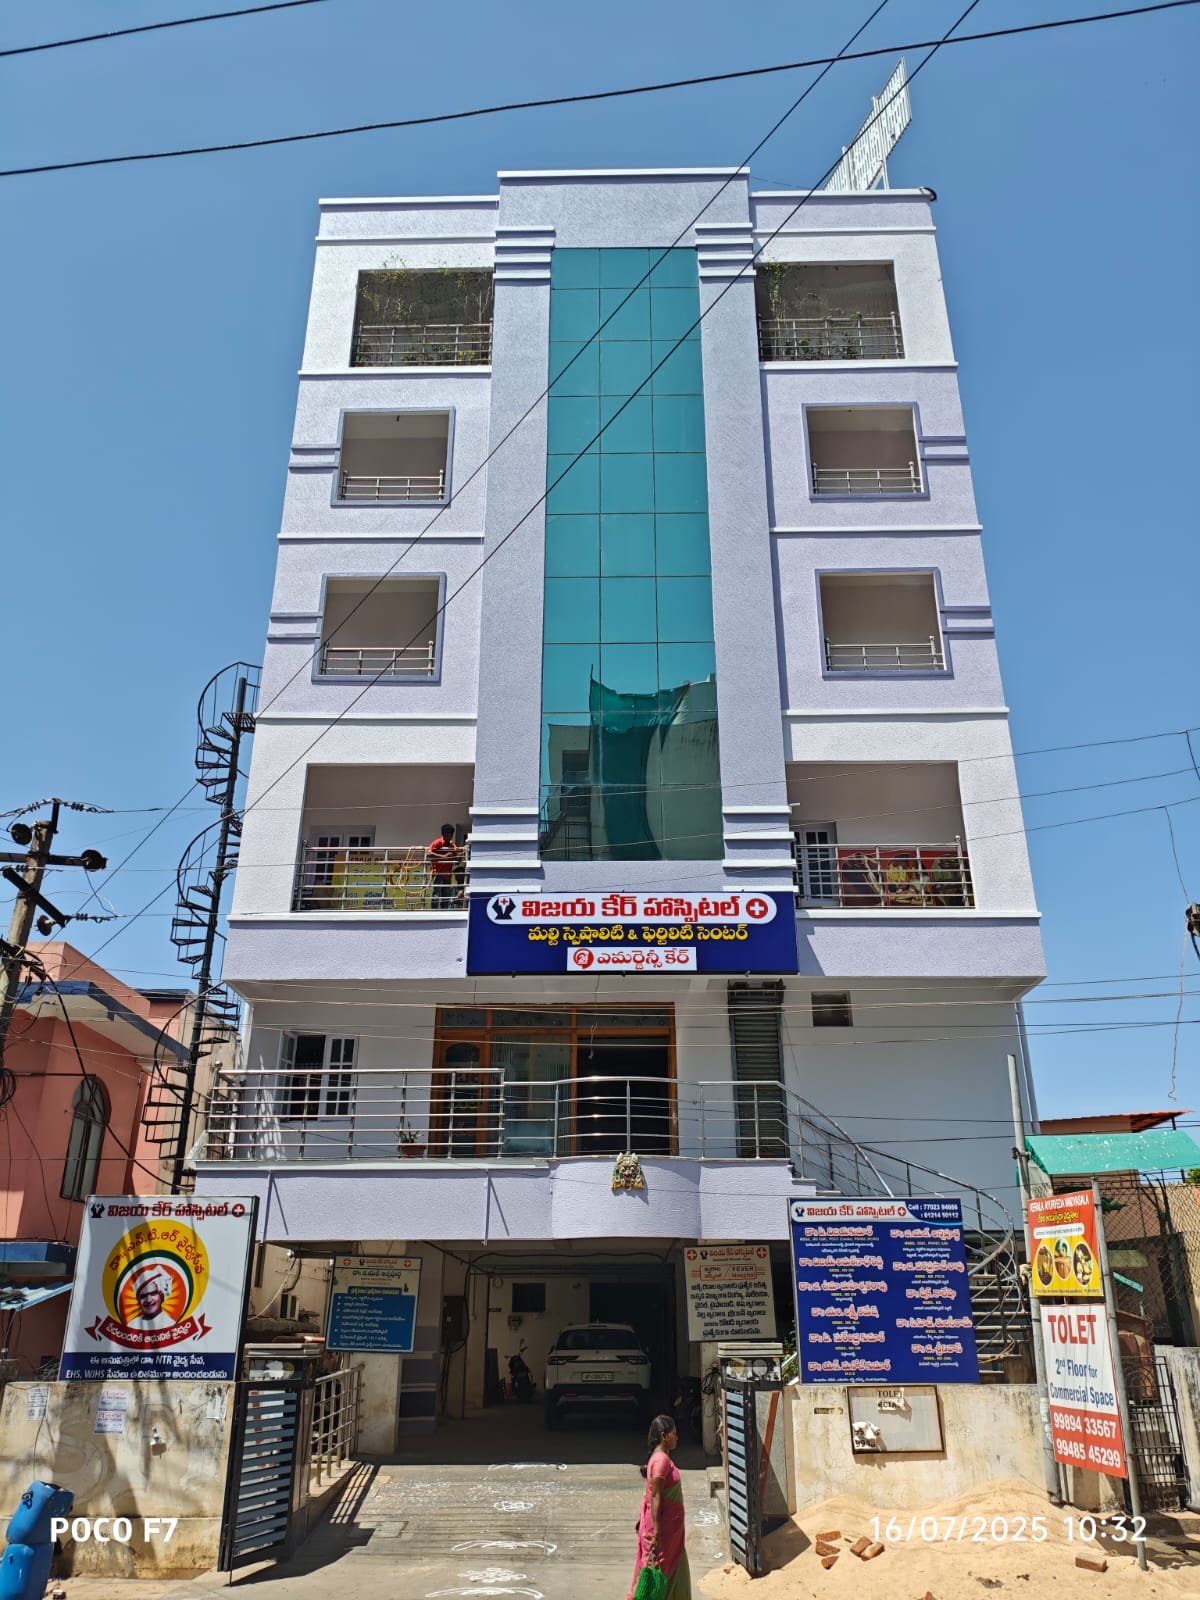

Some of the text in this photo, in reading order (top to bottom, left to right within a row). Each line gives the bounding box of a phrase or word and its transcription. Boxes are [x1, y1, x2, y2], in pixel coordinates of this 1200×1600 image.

[521, 894, 740, 923] విజయ కేర్ హాస్పిటల్
[627, 929, 638, 940] &
[696, 923, 749, 941] సెంటర్
[664, 948, 689, 964] కేర్
[107, 1200, 229, 1221] విజయ కేర్ హాస్పిటల్
[806, 1206, 837, 1216] విజయ
[839, 1203, 854, 1216] కేర్
[1047, 1314, 1097, 1345] TOLET
[155, 1355, 173, 1365] NTR
[1055, 1358, 1098, 1378] 2nd Floor for
[1050, 1382, 1115, 1408] Commercial Space
[1053, 1412, 1117, 1438] 99894 33567
[1056, 1439, 1121, 1468] 99485 45299
